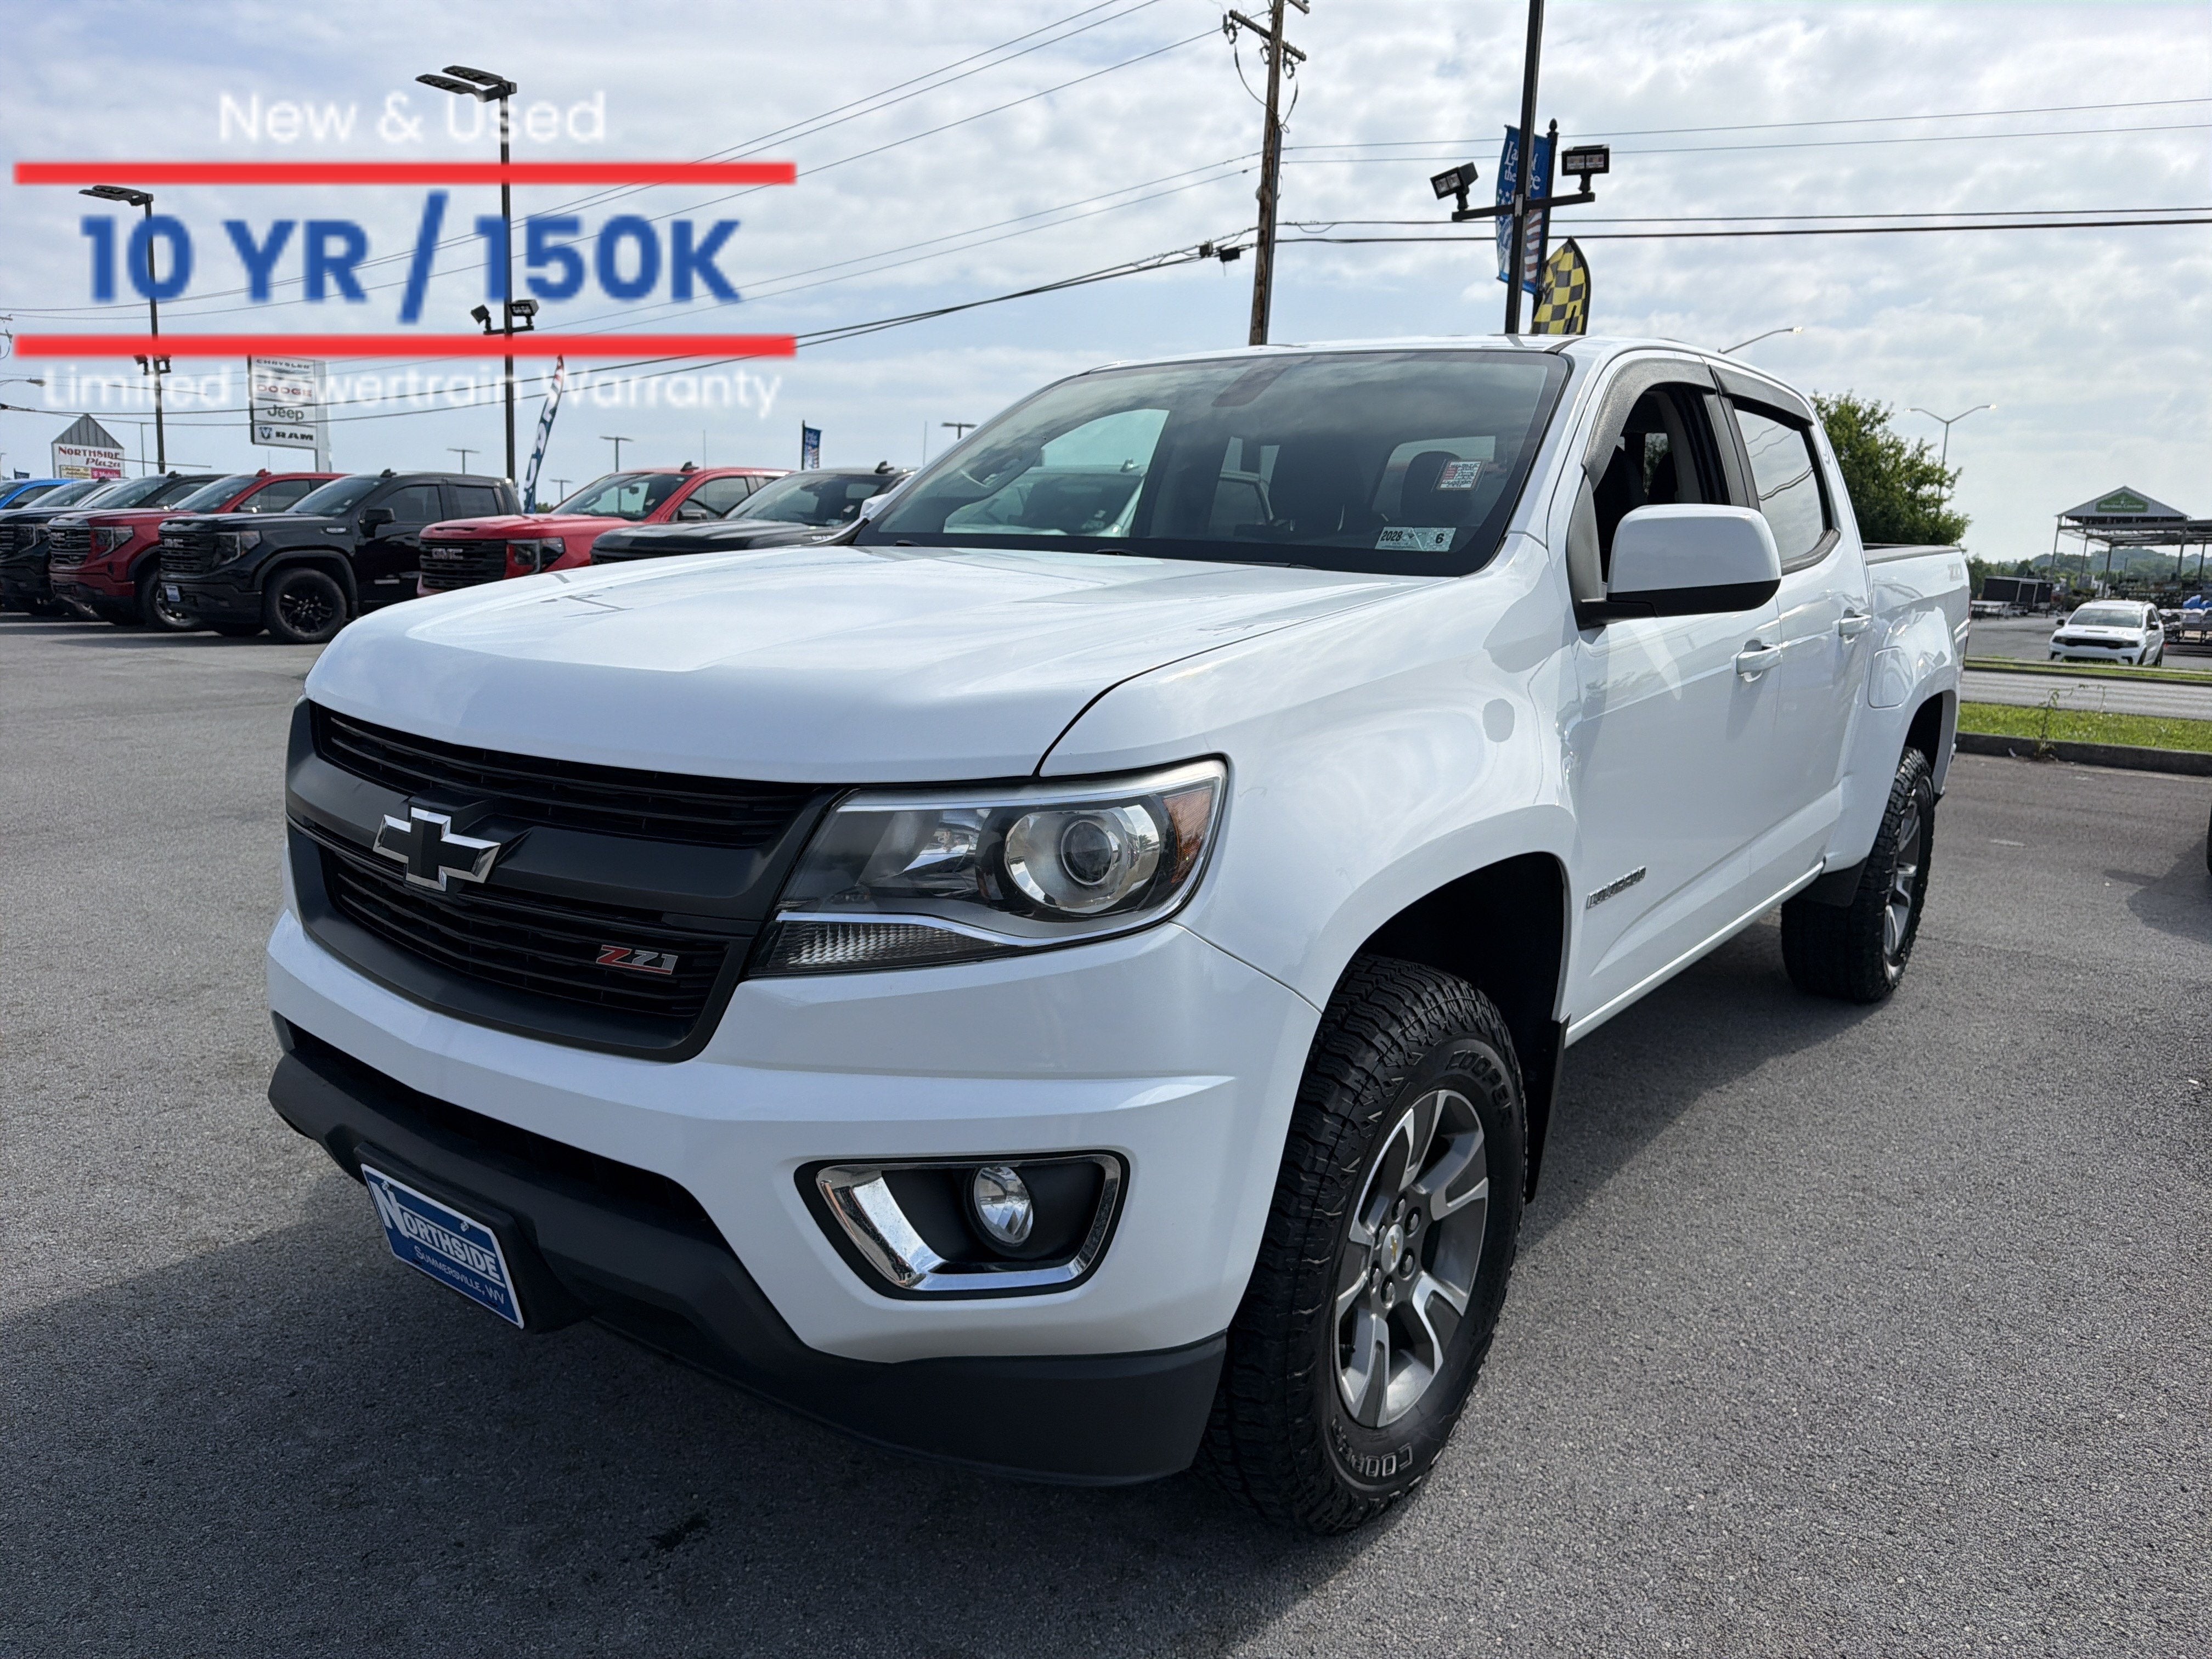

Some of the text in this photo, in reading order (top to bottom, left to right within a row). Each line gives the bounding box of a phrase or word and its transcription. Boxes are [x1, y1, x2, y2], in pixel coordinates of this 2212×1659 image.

[267, 404, 304, 421] Jeep
[275, 431, 314, 441] RAM
[1435, 533, 1444, 544] 6
[596, 944, 679, 975] Z71
[369, 1180, 501, 1281] NORTHSIDE
